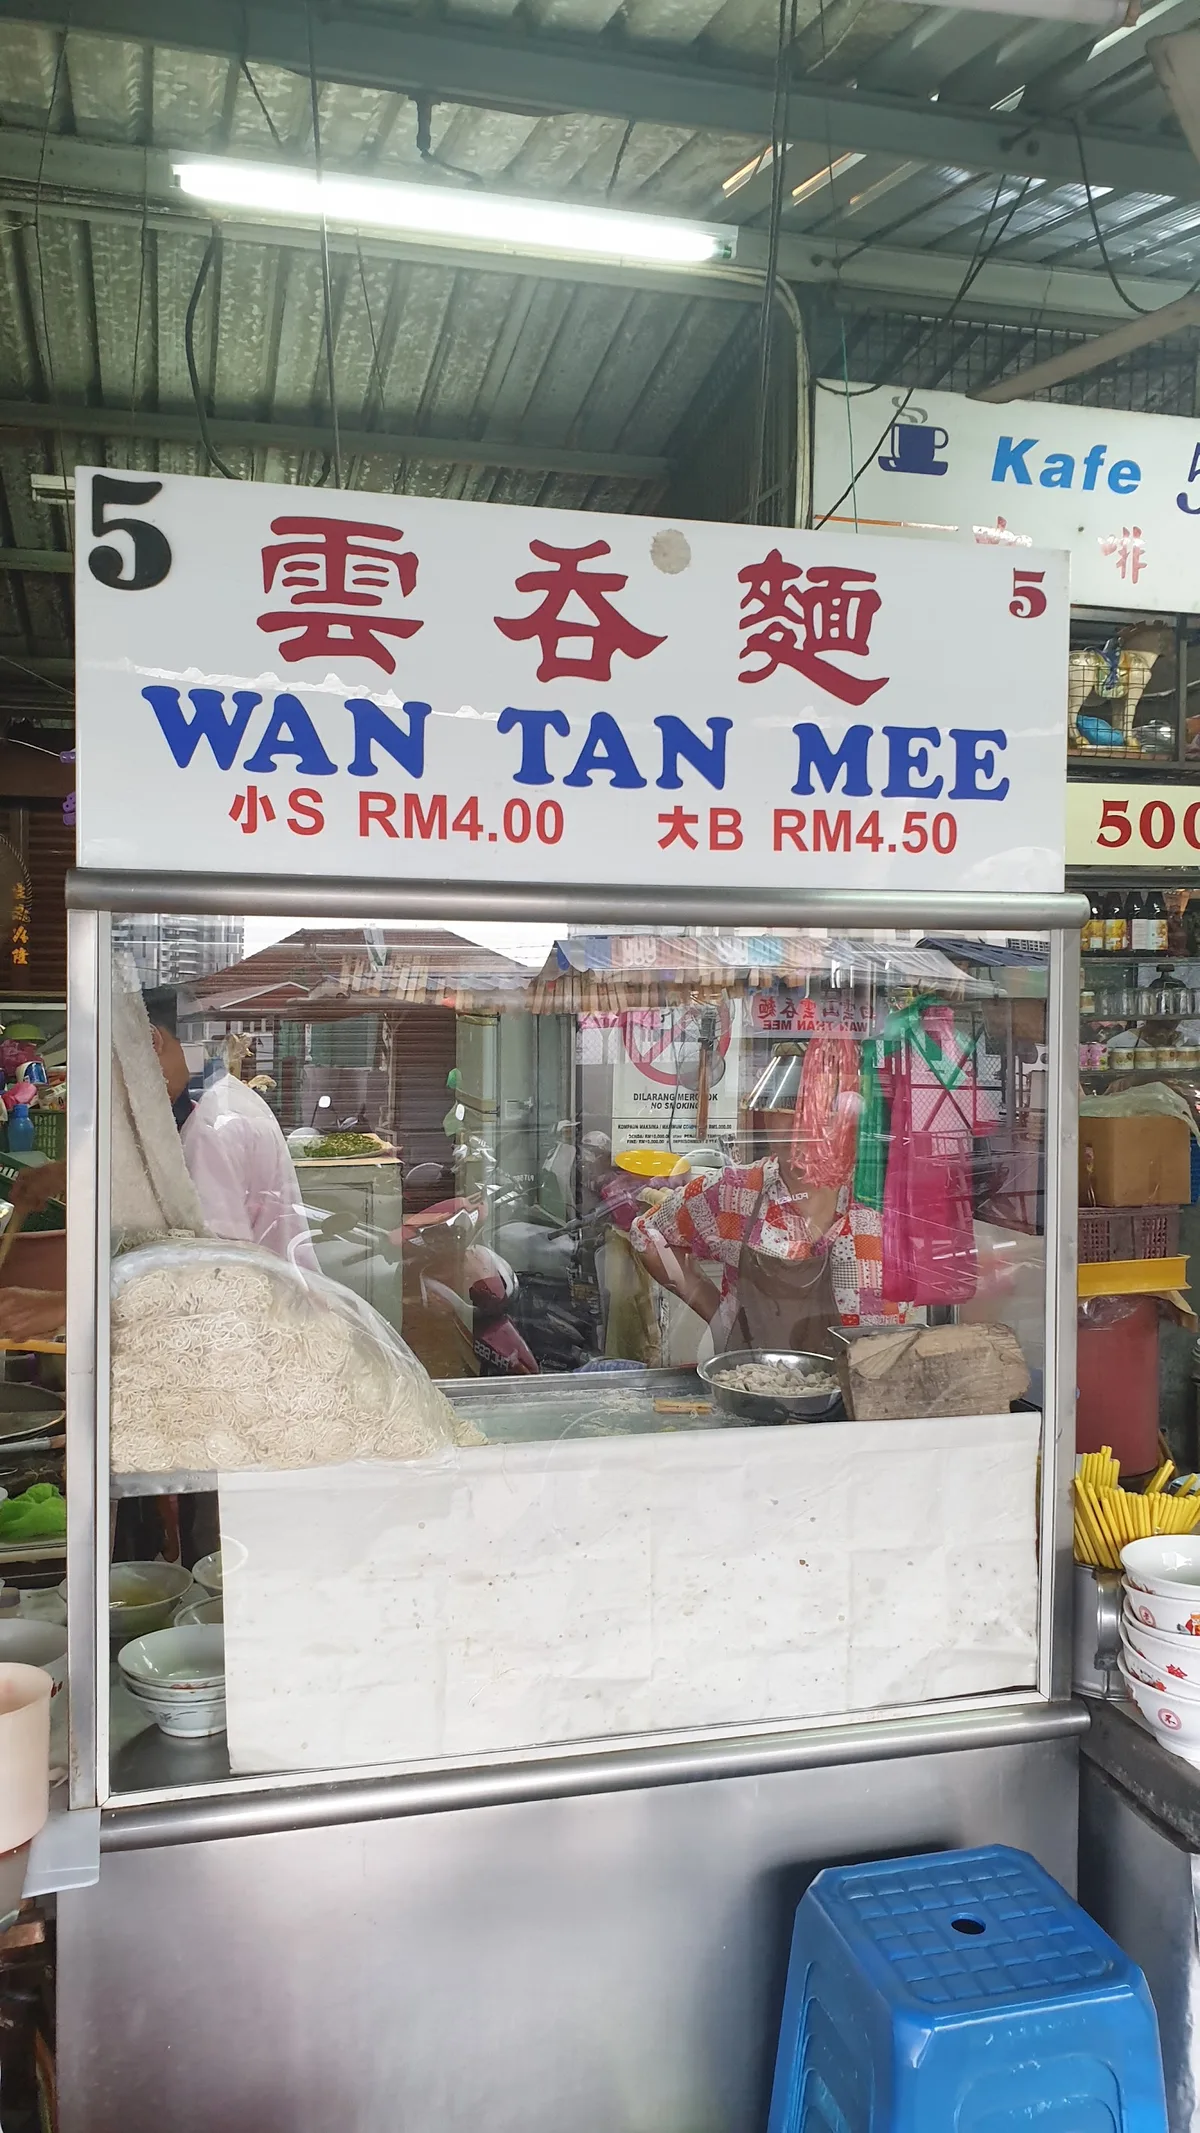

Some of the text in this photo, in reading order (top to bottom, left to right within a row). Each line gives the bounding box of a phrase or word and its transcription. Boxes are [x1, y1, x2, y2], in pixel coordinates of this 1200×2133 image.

[992, 437, 1141, 494] Kafe
[88, 470, 172, 591] 5
[1009, 567, 1048, 618] 5
[141, 685, 1010, 800] WAN TAN MEE
[359, 791, 564, 845] RM4.00
[773, 809, 957, 855] RM4.50
[633, 1093, 675, 1101] DILARANG
